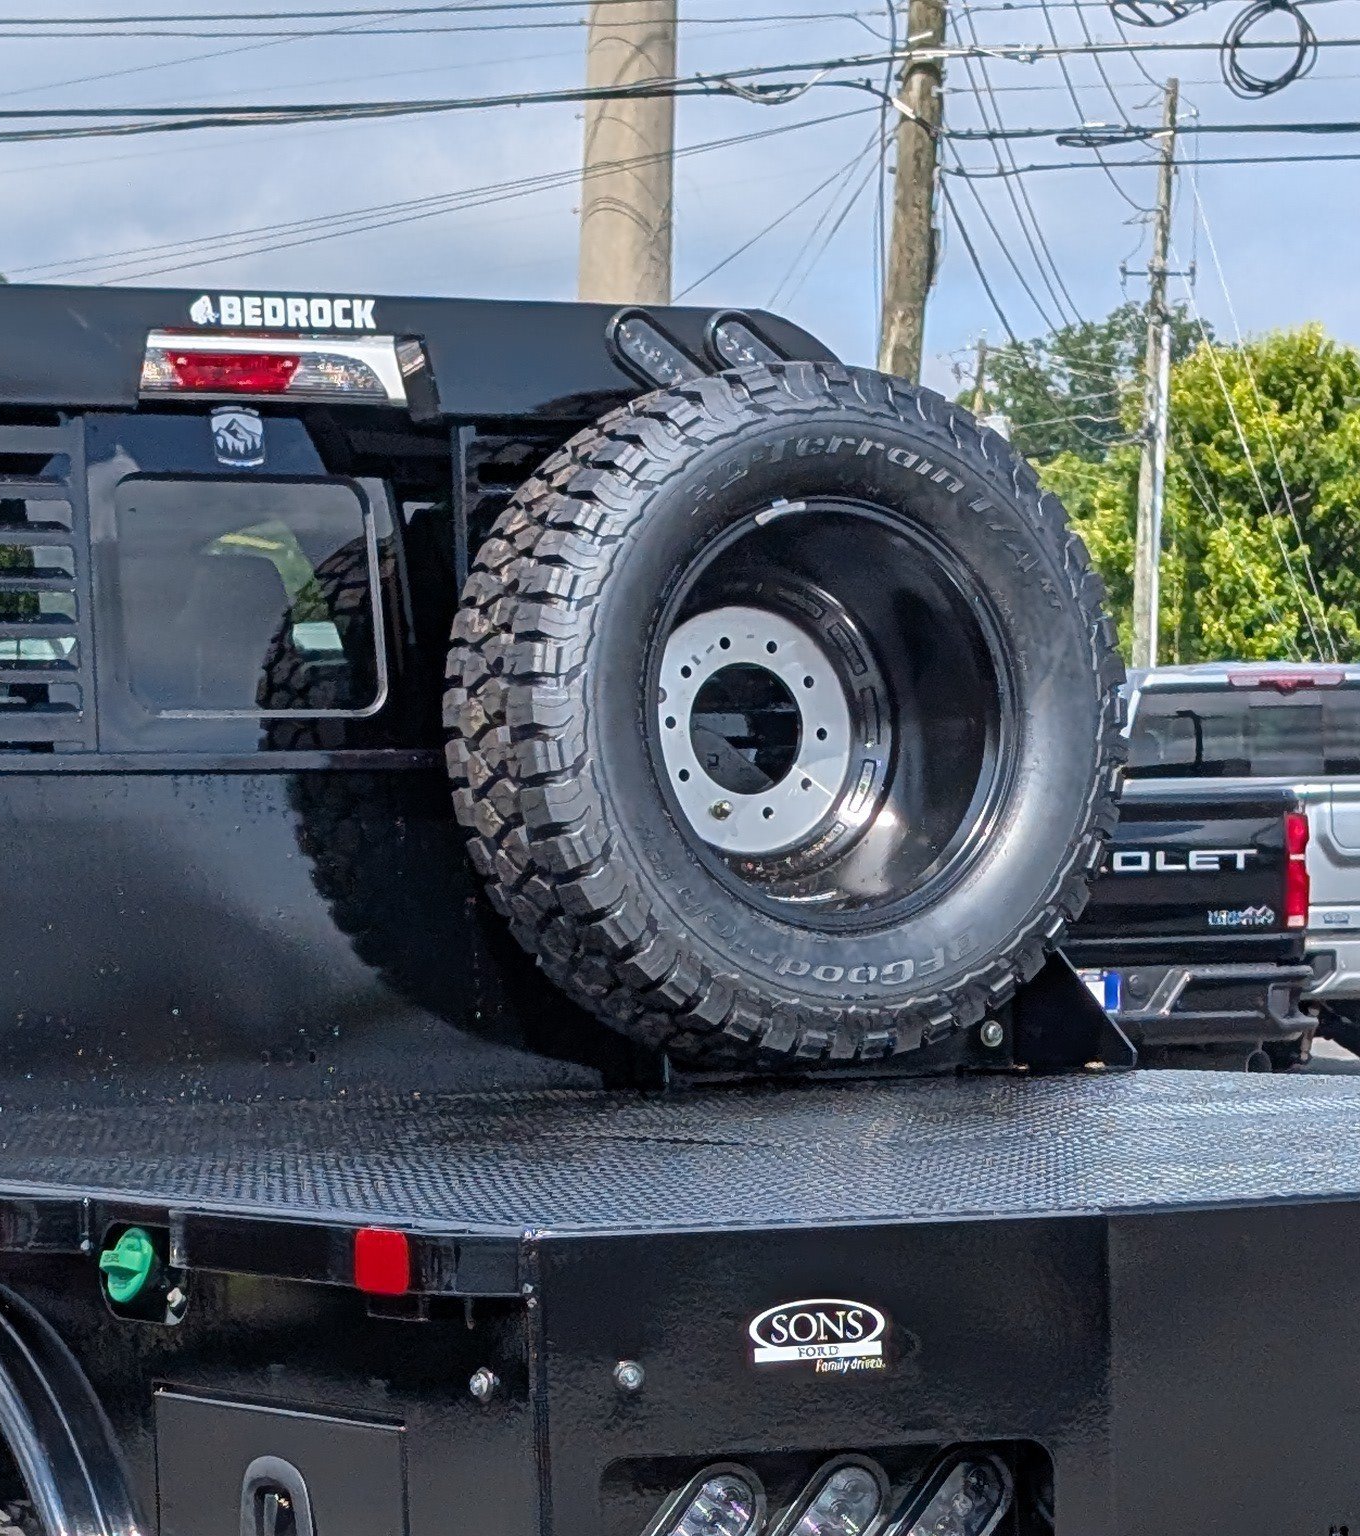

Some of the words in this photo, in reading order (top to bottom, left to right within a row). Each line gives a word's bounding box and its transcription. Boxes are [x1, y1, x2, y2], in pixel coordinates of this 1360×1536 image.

[218, 295, 377, 330] BEDROCK
[1100, 848, 1258, 873] OLET
[770, 1309, 864, 1344] SONS
[797, 1345, 840, 1358] FORD
